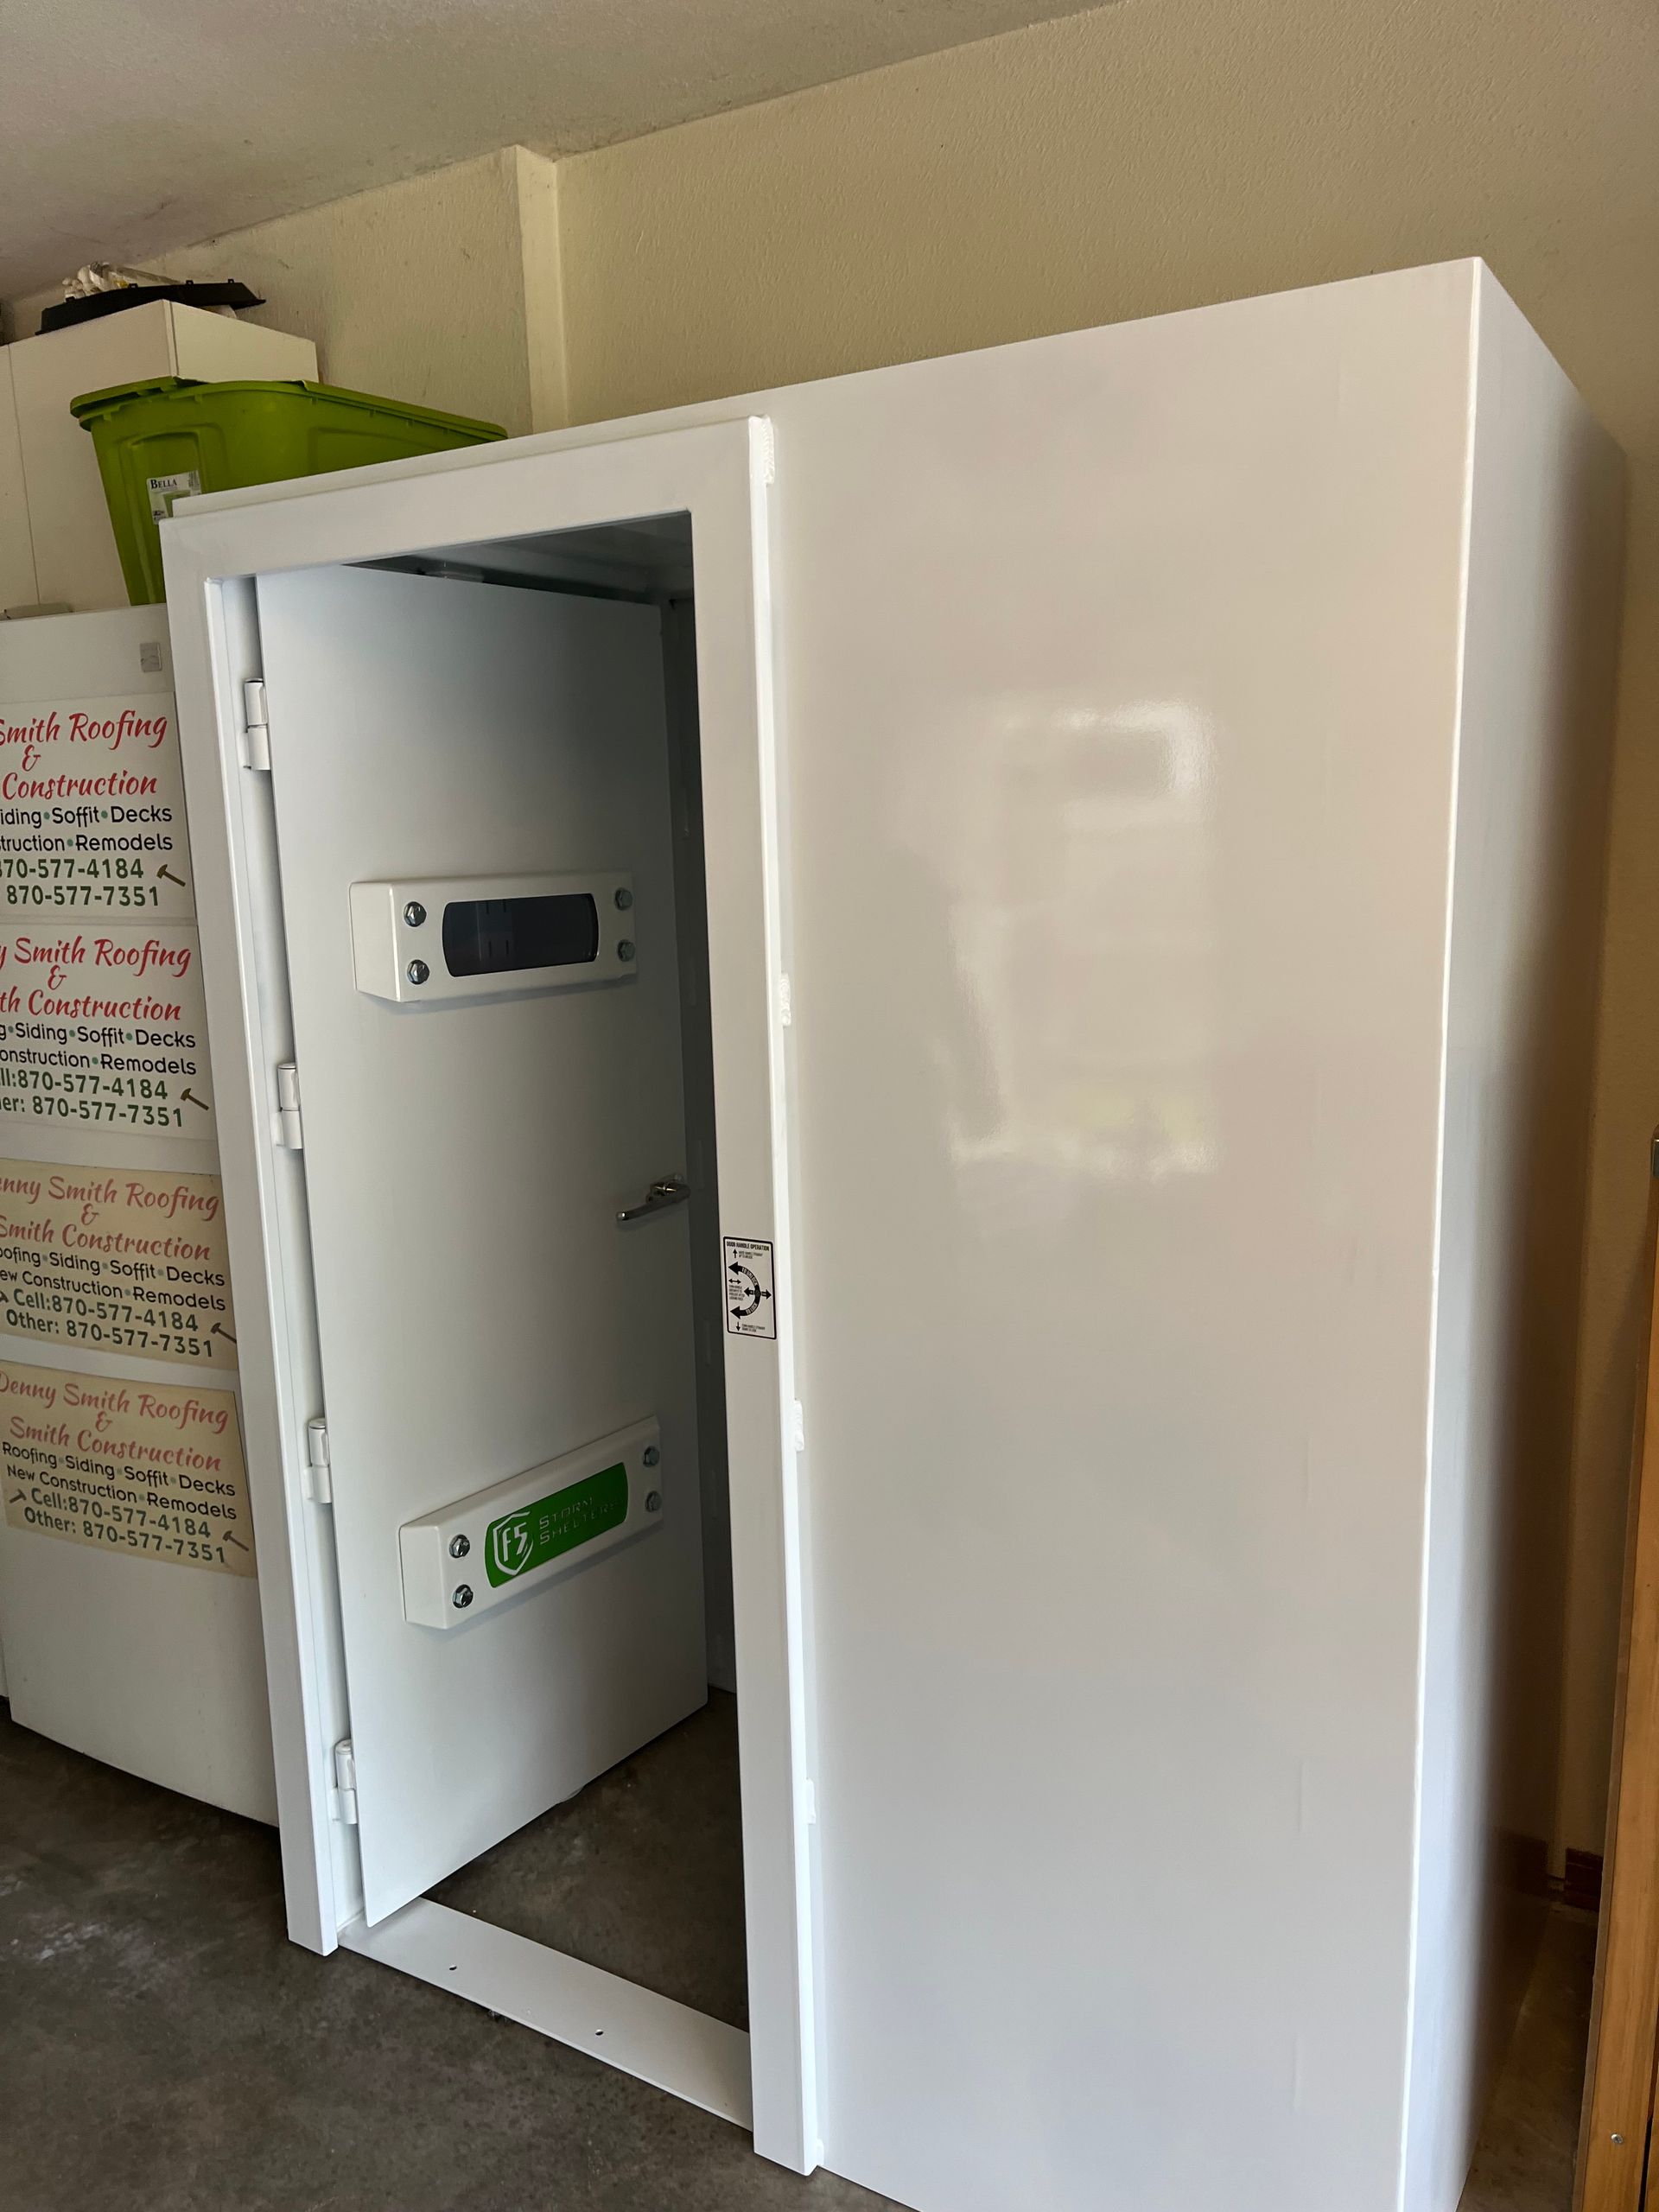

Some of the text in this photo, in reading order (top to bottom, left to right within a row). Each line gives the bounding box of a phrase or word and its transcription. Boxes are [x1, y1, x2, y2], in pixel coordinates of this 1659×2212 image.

[150, 479, 177, 489] BELLA
[69, 710, 168, 750] Roofing
[22, 745, 41, 772] &
[3, 770, 157, 800] Construction
[52, 806, 99, 828] Soffit
[111, 804, 172, 823] Decks
[0, 833, 173, 852] truction Remodels
[7, 885, 158, 906] 870-577-7351
[14, 934, 86, 964] Smith
[93, 938, 192, 977] Roofing
[48, 964, 67, 990] &
[28, 989, 181, 1020] Construction
[16, 1022, 67, 1045] Siding
[78, 1026, 124, 1047] Soffit
[135, 1029, 195, 1048] Decks
[100, 1053, 196, 1075] Remodels
[33, 1096, 181, 1127] 870-577-7351
[48, 1175, 118, 1203] Smith
[125, 1182, 219, 1221] Roofing
[81, 1203, 99, 1225] &
[62, 1224, 210, 1260] Construction
[49, 1252, 100, 1275] Siding
[110, 1260, 156, 1281] Soffit
[166, 1266, 225, 1286] Decks
[22, 1270, 123, 1299] Construction
[133, 1286, 226, 1311] Remodels
[6, 1309, 213, 1357] Other: 870-577-7351
[63, 1383, 130, 1413] Smith
[138, 1395, 229, 1434] Roofing
[95, 1411, 112, 1432] &
[10, 1415, 221, 1471] Smith Construction
[2, 1441, 235, 1497] Roofing Siding Soffit Decks
[7, 1464, 237, 1520] New Construction Remodels
[24, 1507, 226, 1563] Other: 870-577-7351
[502, 1522, 528, 1562] F5
